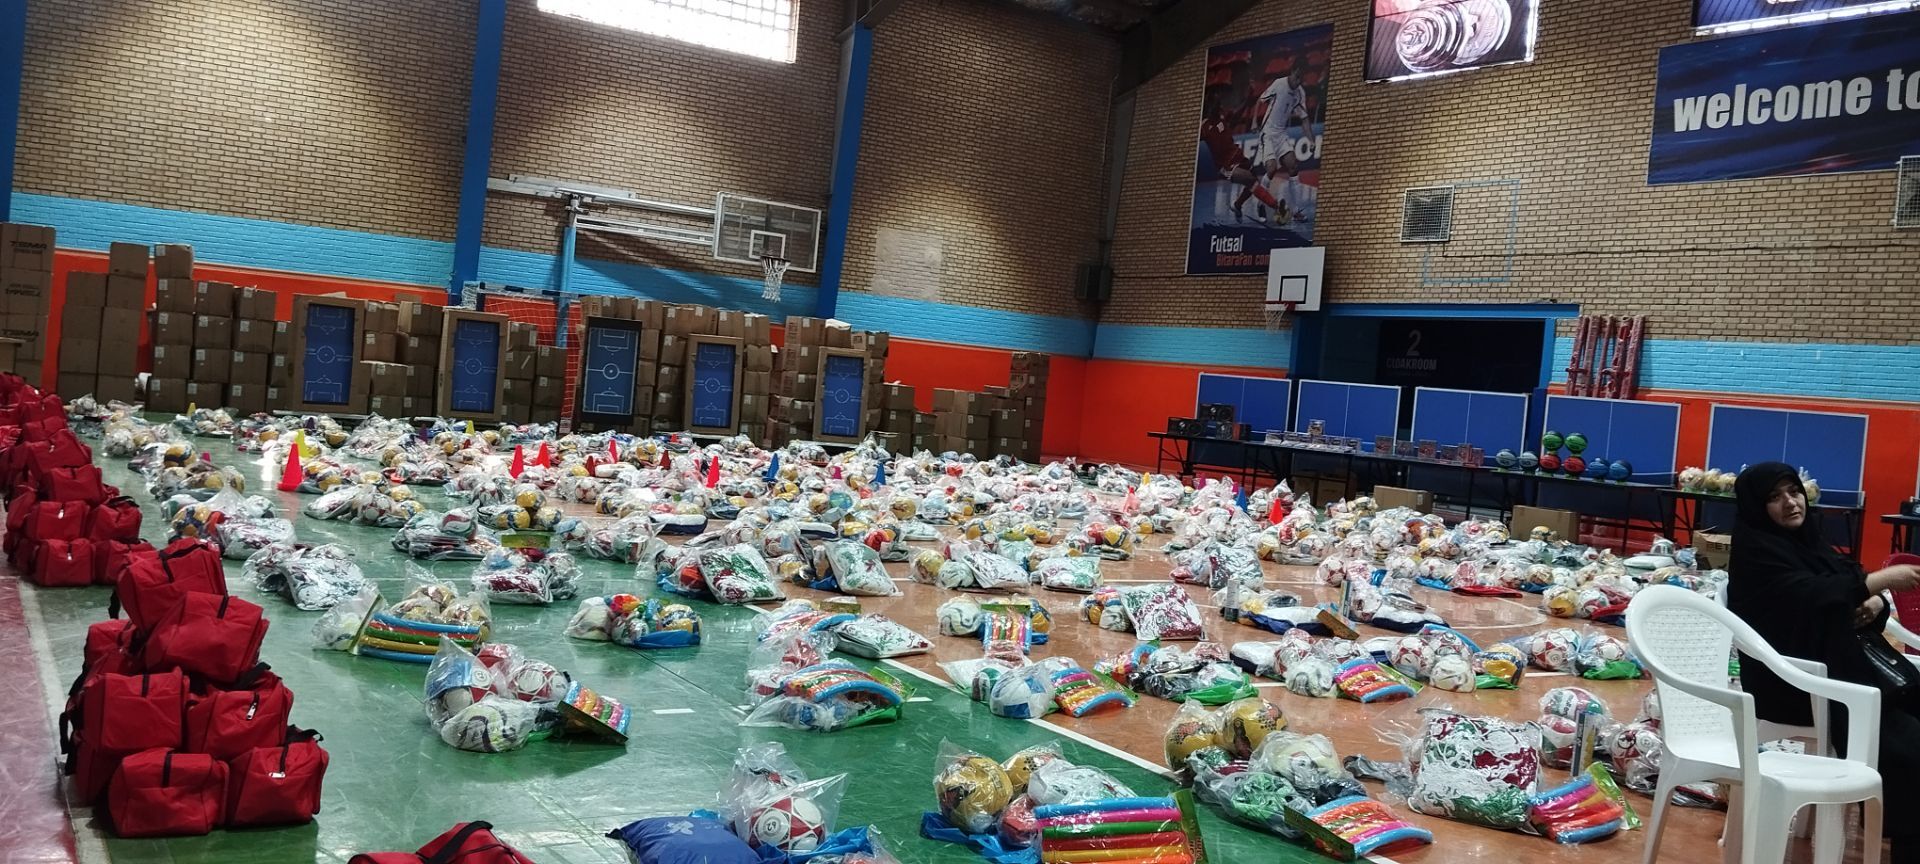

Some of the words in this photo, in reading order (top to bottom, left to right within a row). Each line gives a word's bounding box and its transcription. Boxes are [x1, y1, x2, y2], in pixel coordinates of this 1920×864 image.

[1673, 77, 1873, 132] welcome
[1210, 234, 1244, 253] Futsal
[1406, 328, 1422, 356] 2
[1386, 358, 1438, 370] CLOAKROOM
